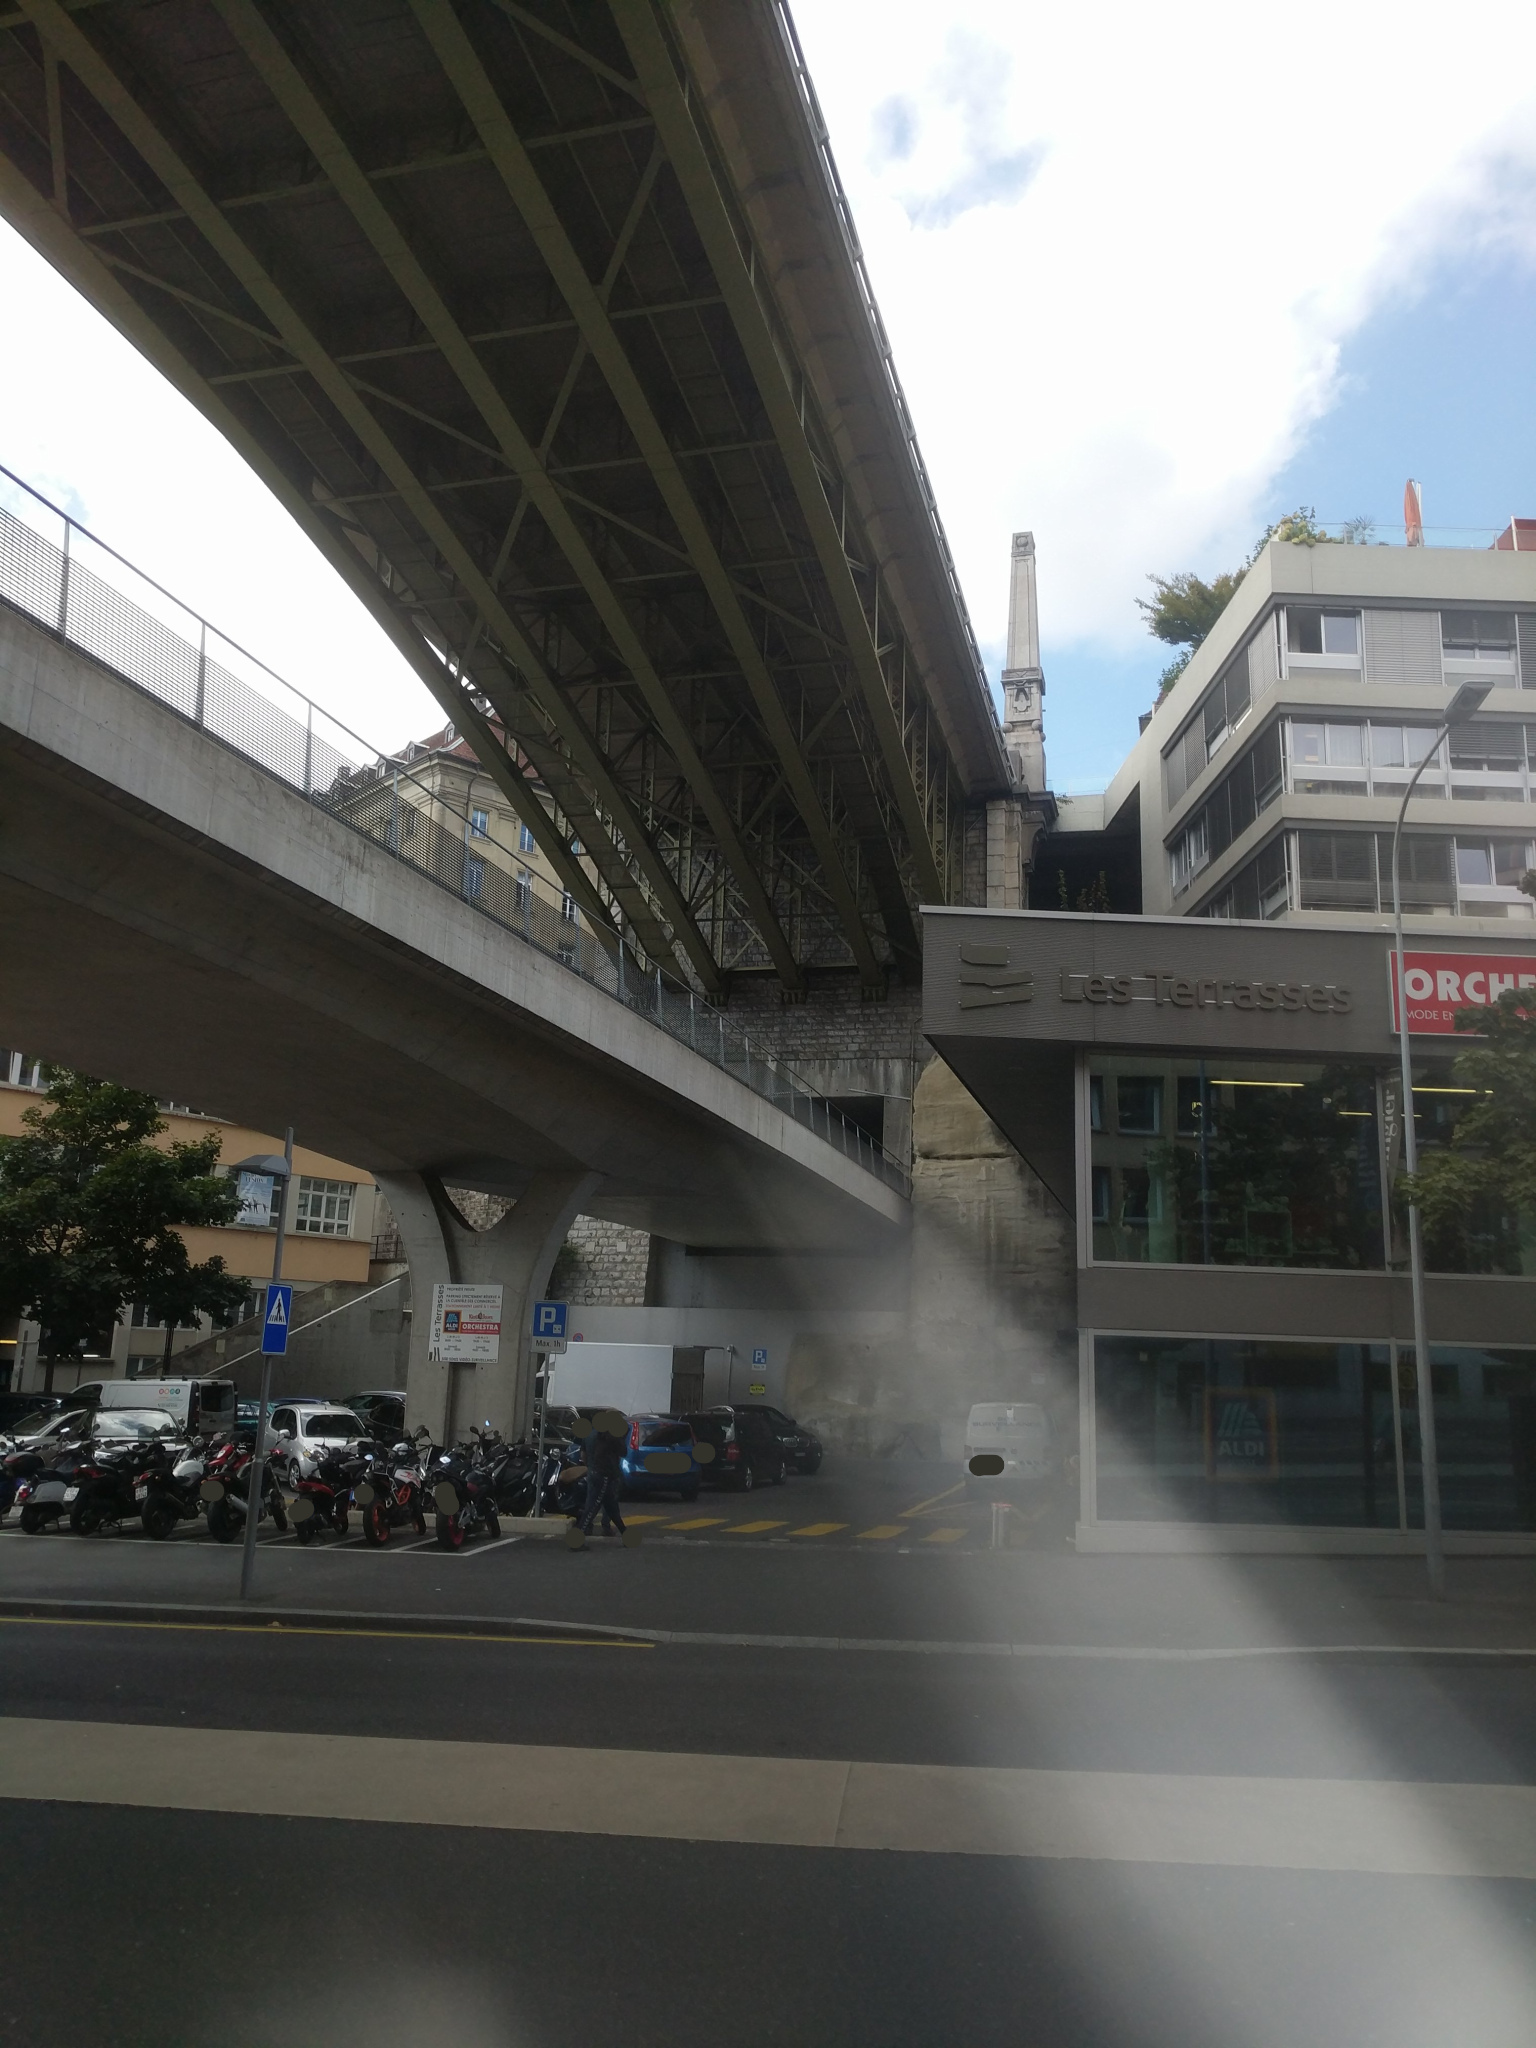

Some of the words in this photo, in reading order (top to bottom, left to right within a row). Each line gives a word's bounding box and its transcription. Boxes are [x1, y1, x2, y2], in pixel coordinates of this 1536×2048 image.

[1060, 966, 1133, 1003] Les
[1145, 969, 1352, 1014] Terrasses
[1406, 1010, 1439, 1020] MODE
[434, 1284, 445, 1326] Terrasses
[539, 1306, 557, 1332] P
[433, 1327, 441, 1342] Les
[462, 1323, 499, 1331] ORCHESTRA
[553, 1339, 561, 1348] 1h
[755, 1350, 763, 1362] P
[1217, 1440, 1265, 1456] ALDI
